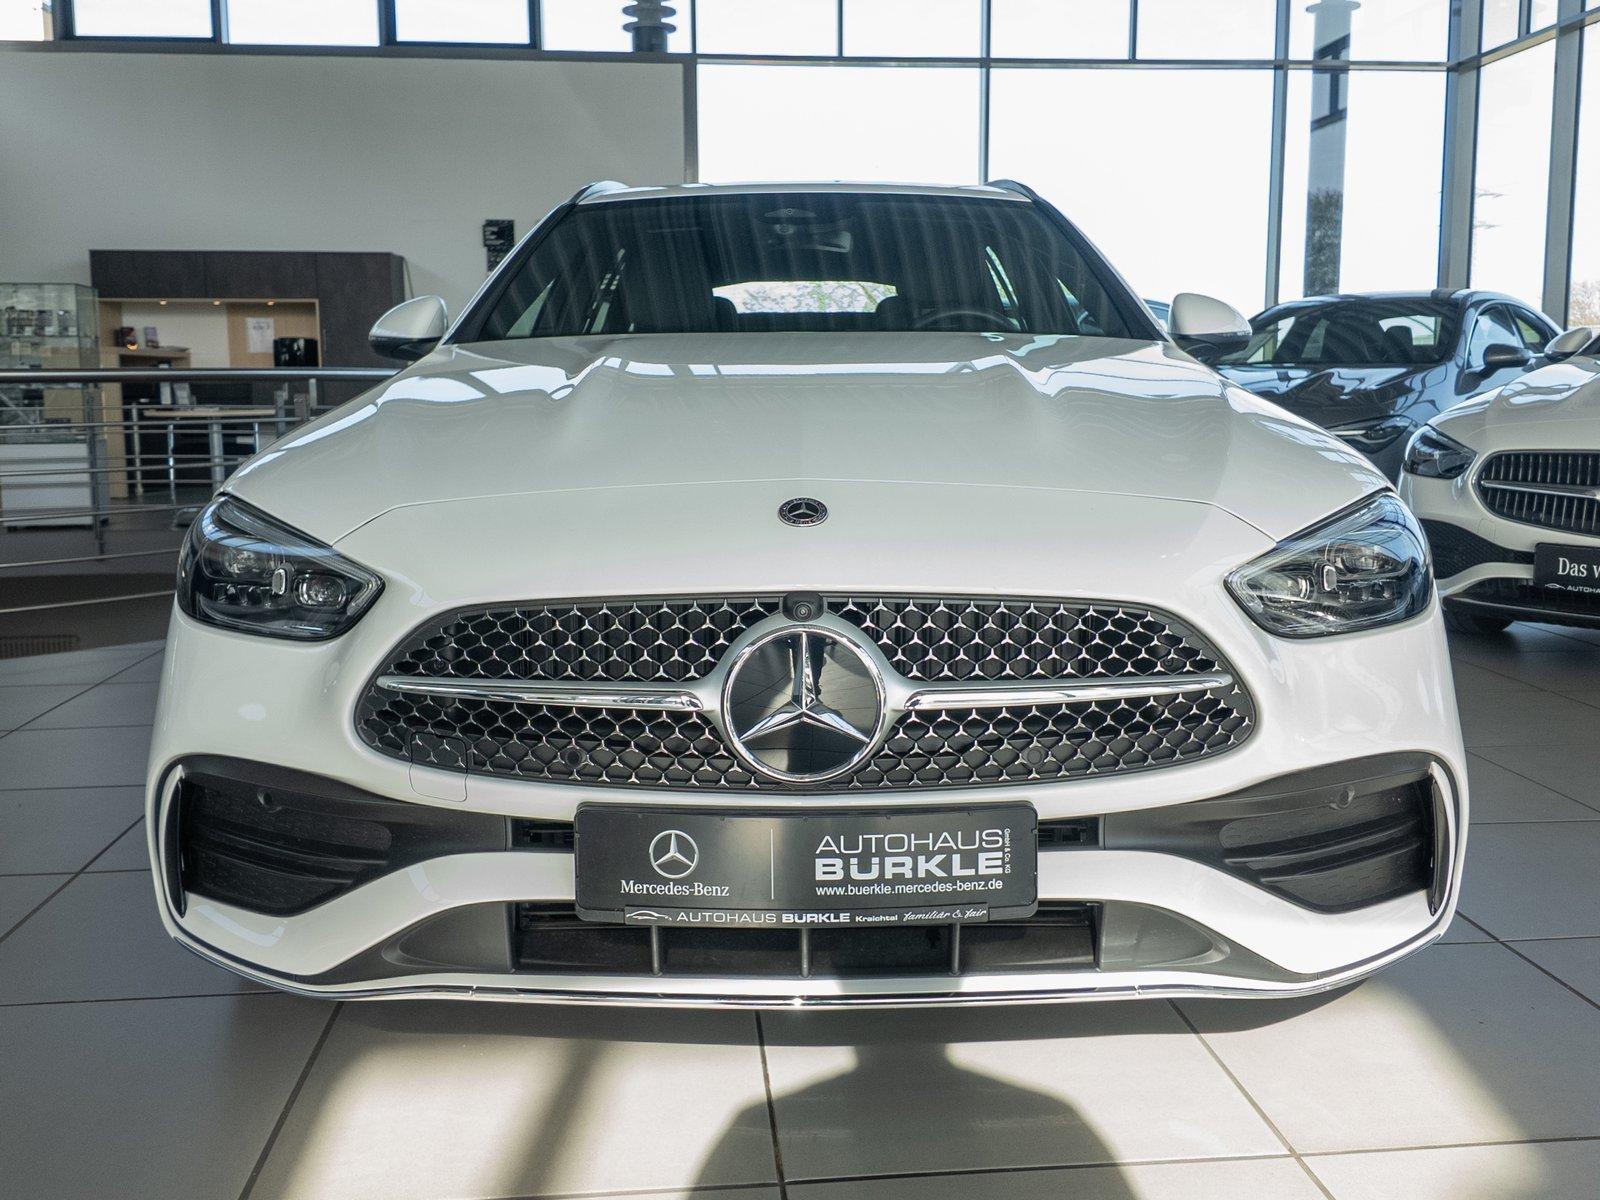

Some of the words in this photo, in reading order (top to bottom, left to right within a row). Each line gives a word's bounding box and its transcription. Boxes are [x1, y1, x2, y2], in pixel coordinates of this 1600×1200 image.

[1557, 557, 1587, 578] Das
[815, 829, 1003, 854] AUTOHAUS
[815, 851, 1003, 881] BÜRKLE
[1004, 864, 1011, 874] KG
[620, 879, 730, 897] Mercedes-Benz
[815, 878, 1004, 896] www.buerkle.mercedes-benz.de
[676, 911, 777, 923] AUTOHAUS
